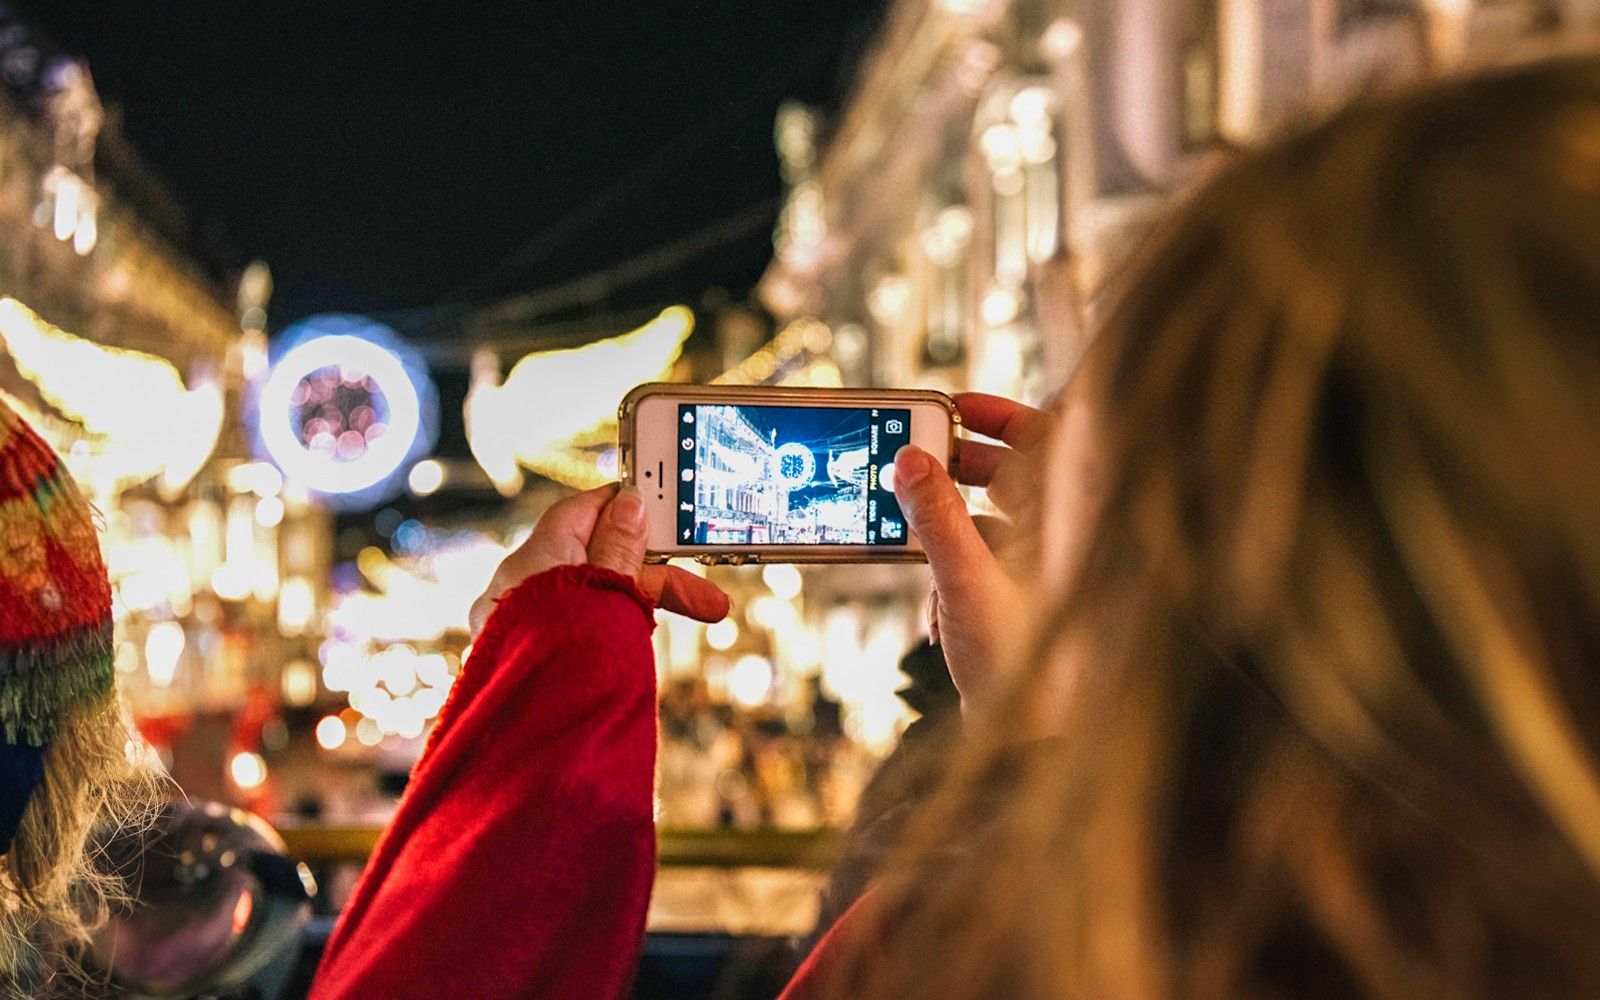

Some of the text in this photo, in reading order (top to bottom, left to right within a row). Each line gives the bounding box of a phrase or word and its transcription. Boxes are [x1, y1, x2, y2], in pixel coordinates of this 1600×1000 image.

[871, 425, 879, 454] SQUARE
[870, 465, 878, 490] PHOTO
[869, 500, 877, 522] VIDEO
